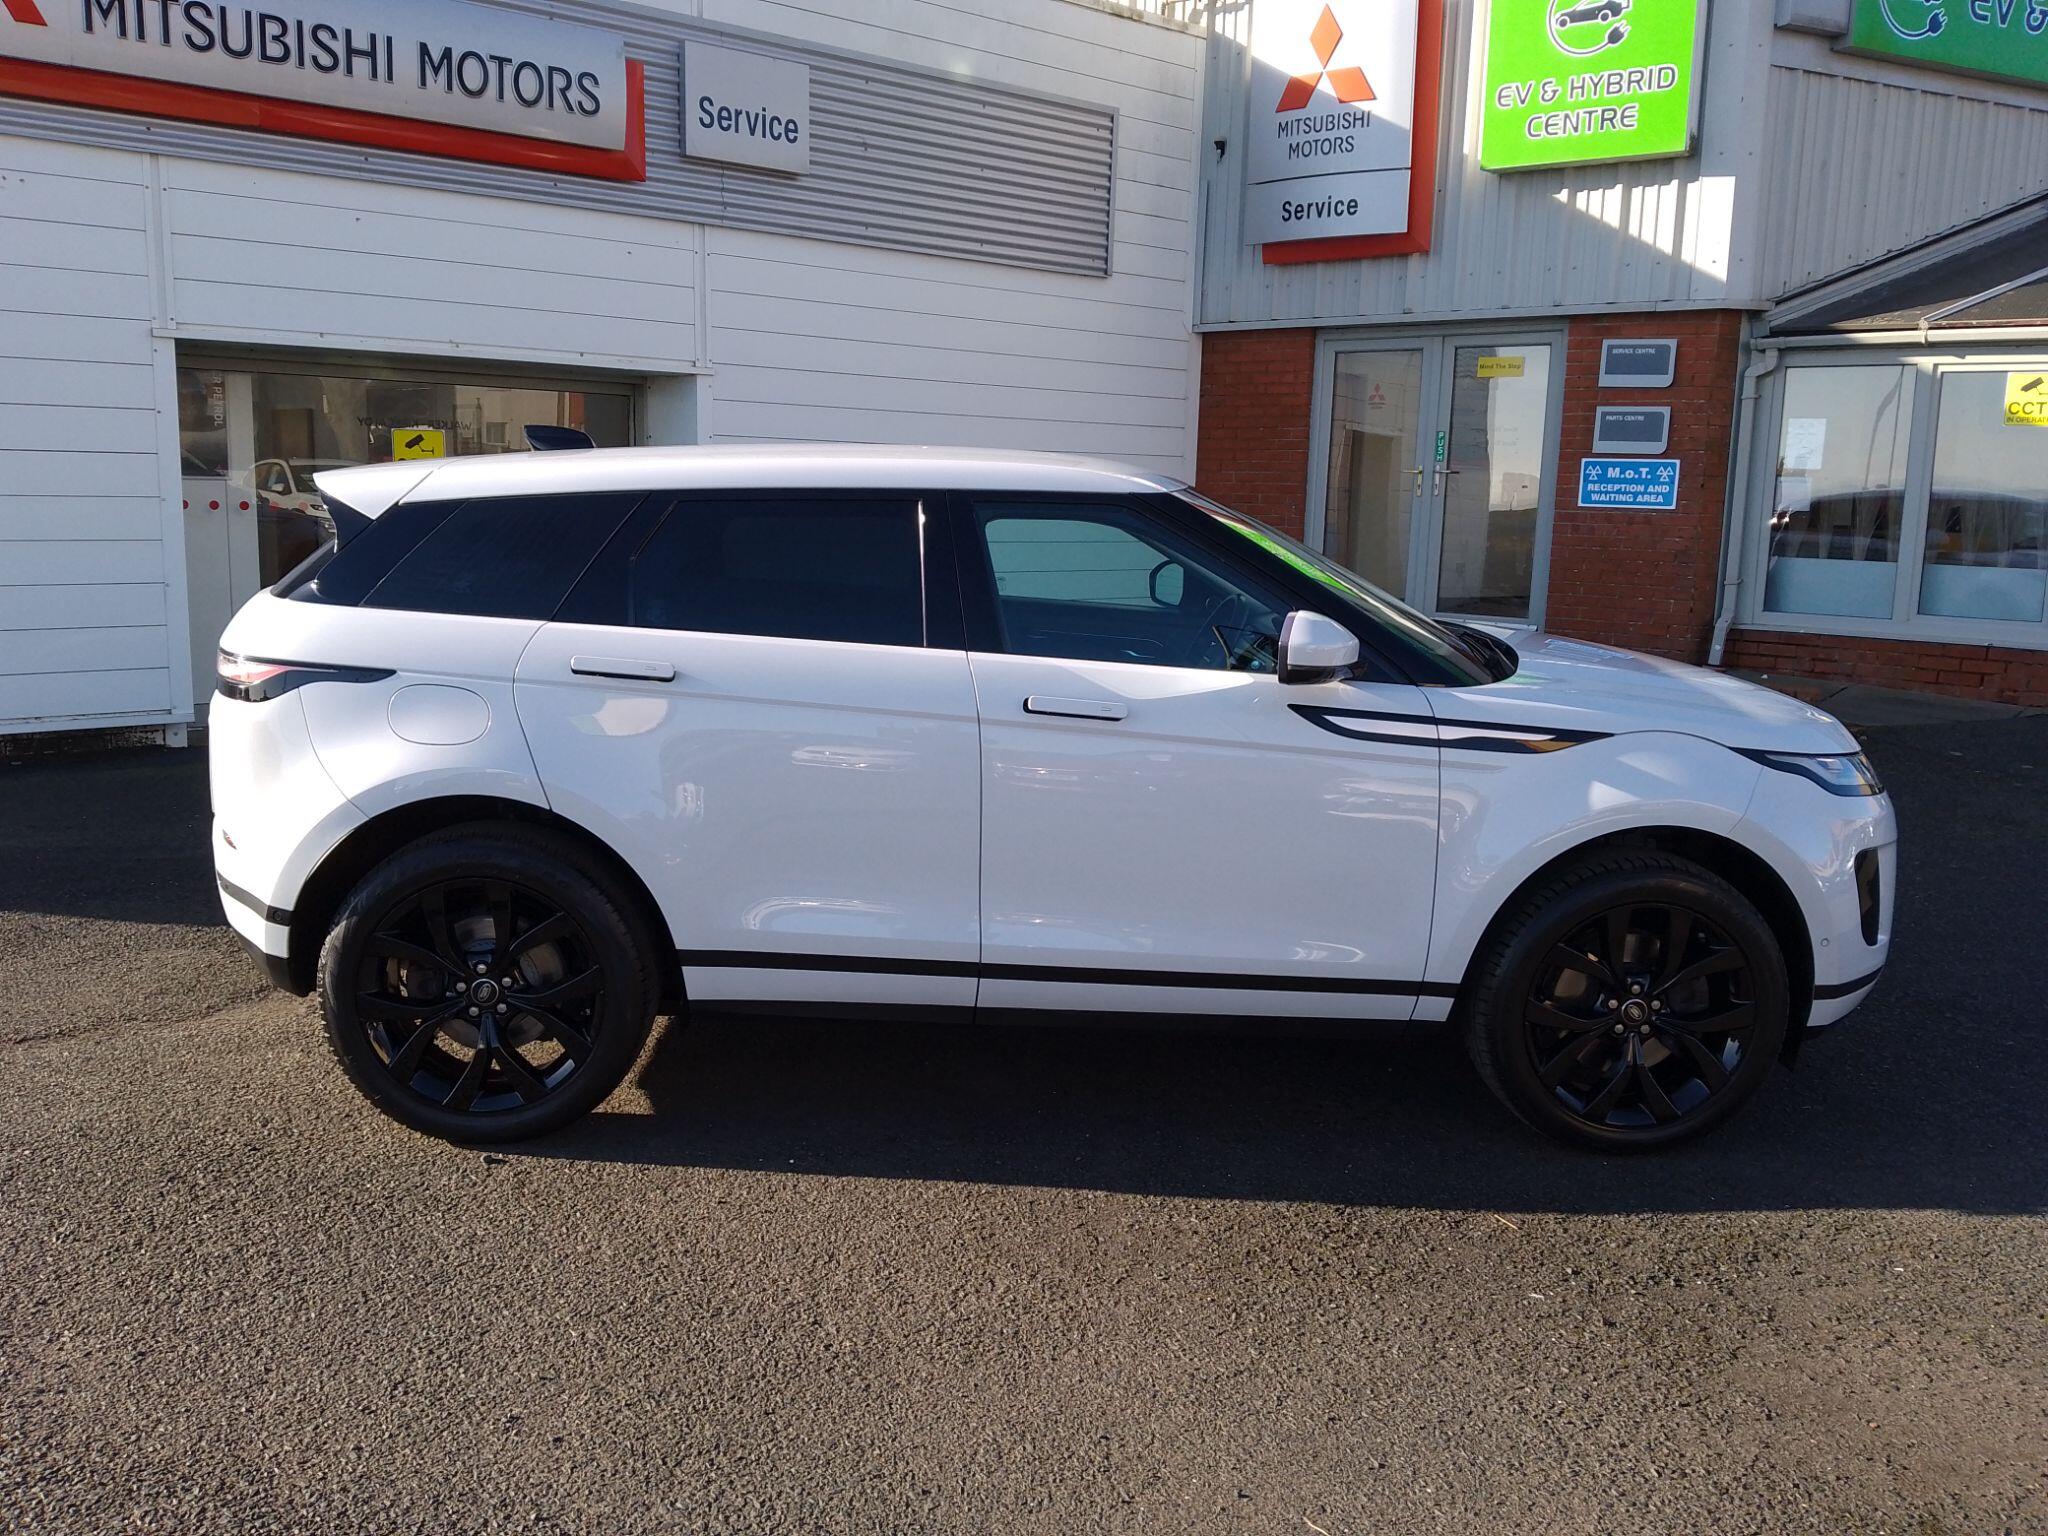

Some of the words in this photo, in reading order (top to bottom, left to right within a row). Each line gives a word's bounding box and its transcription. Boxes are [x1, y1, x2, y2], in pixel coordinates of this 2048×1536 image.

[1969, 0, 2015, 27] EV
[82, 0, 394, 83] MITSUBISHI
[417, 40, 600, 117] MOTORS
[1498, 82, 1532, 108] EV
[1541, 80, 1560, 103] &
[1569, 65, 1677, 100] HYBRID
[699, 95, 799, 144] Service
[1277, 110, 1372, 139] MITSUBISHI
[1527, 105, 1638, 138] CENTRE
[1288, 135, 1355, 160] MOTORS
[1281, 195, 1359, 222] Service
[1436, 431, 1444, 461] PUSH
[1607, 467, 1651, 479] M.o.T.
[1587, 483, 1644, 492] RECEPTION
[1647, 484, 1670, 493] AND
[1591, 493, 1633, 502] WAITING
[1636, 494, 1664, 503] AREA
